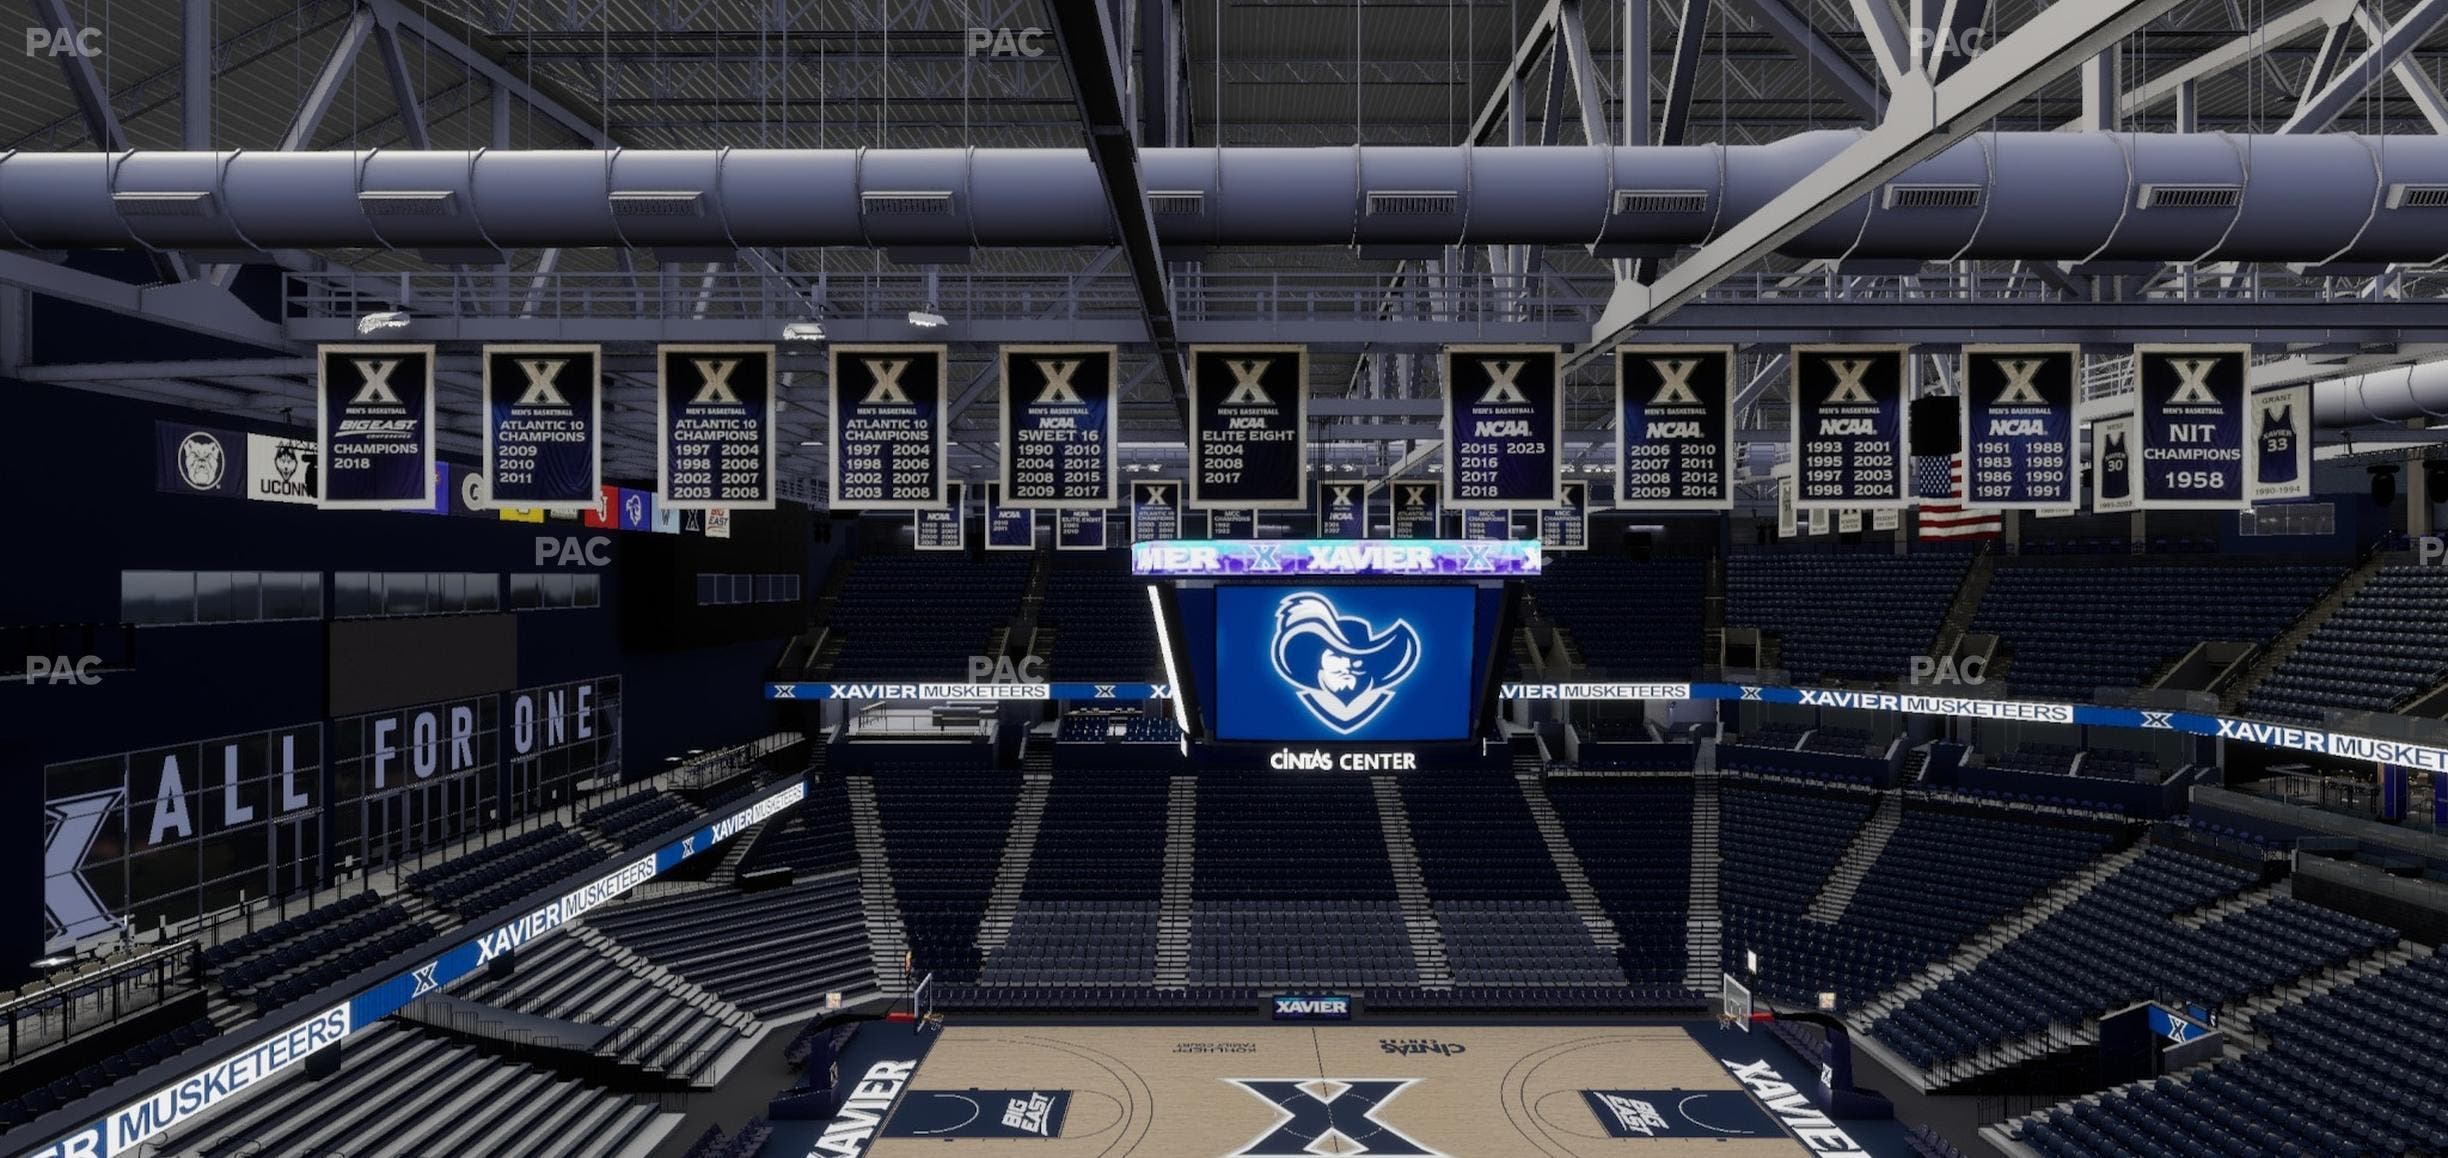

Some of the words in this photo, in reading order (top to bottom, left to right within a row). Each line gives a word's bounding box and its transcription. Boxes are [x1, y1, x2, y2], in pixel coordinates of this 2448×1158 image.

[501, 421, 566, 430] ATLANTIC
[570, 421, 584, 430] 10
[676, 420, 740, 429] ATLANTIC
[744, 420, 757, 429] 10
[846, 420, 910, 429] ATLANTIC
[914, 420, 928, 429] 10
[1039, 418, 1076, 429] NCAA
[1229, 418, 1266, 429] NCAA
[1475, 421, 1529, 437] NCAA
[1820, 419, 1875, 435] NCAA
[1989, 420, 2044, 435] NCAA
[1018, 430, 1076, 441] SWEET
[1082, 430, 1098, 441] 16
[1646, 422, 1701, 438] NCAA
[2169, 424, 2216, 442] NIT
[499, 432, 585, 442] CHAMPIONS
[674, 431, 758, 441] CHAMPIONS
[845, 431, 929, 441] CHAMPIONS
[1202, 431, 1246, 441] ELITE
[1250, 431, 1296, 441] EIGHT
[334, 444, 418, 454] CHAMPIONS
[676, 445, 711, 455] 1997
[721, 445, 759, 455] 2004
[847, 445, 882, 455] 1997
[892, 445, 930, 455] 2004
[1018, 444, 1053, 455] 1990
[1064, 444, 1100, 455] 2010
[1204, 444, 1244, 455] 2004
[1461, 443, 1498, 454] 2015
[1507, 443, 1546, 454] 2023
[1632, 445, 1670, 456] 2006
[1680, 445, 1716, 455] 2010
[1807, 442, 1842, 453] 1993
[1854, 442, 1890, 453] 2001
[1977, 443, 2010, 453] 1961
[2026, 443, 2063, 453] 1988
[2268, 438, 2288, 452] 33
[499, 446, 537, 456] 2009
[2144, 449, 2241, 460] CHAMPIONS
[334, 458, 370, 469] 2018
[500, 459, 535, 470] 2010
[676, 459, 711, 470] 1998
[721, 459, 759, 470] 2006
[847, 459, 882, 470] 1998
[892, 459, 930, 470] 2006
[1017, 458, 1054, 469] 2004
[1064, 458, 1100, 469] 2012
[1204, 458, 1243, 469] 2008
[1462, 457, 1498, 468] 2016
[1632, 459, 1670, 470] 2007
[1681, 459, 1714, 469] 2011
[1807, 456, 1842, 467] 1995
[1854, 456, 1893, 467] 2002
[1977, 457, 2012, 468] 1983
[2026, 457, 2063, 468] 1989
[2108, 460, 2123, 472] 30
[500, 473, 532, 484] 2011
[674, 473, 711, 484] 2002
[721, 473, 759, 484] 2007
[845, 473, 882, 484] 2002
[892, 473, 930, 484] 2007
[1017, 472, 1054, 483] 2008
[1064, 472, 1100, 483] 2015
[1205, 473, 1241, 483] 2017
[1462, 471, 1498, 482] 2017
[1632, 473, 1670, 484] 2008
[1682, 473, 1718, 483] 2012
[1807, 470, 1842, 481] 1997
[1854, 470, 1893, 481] 2003
[1977, 471, 2012, 482] 1986
[2026, 471, 2063, 482] 1990
[2166, 472, 2224, 488] 1958
[674, 487, 711, 498] 2003
[721, 487, 759, 498] 2008
[845, 487, 882, 498] 2003
[892, 487, 930, 498] 2008
[1017, 486, 1055, 497] 2009
[1064, 486, 1100, 497] 2017
[1462, 486, 1498, 497] 2018
[1632, 487, 1670, 498] 2009
[1682, 486, 1717, 496] 2014
[1807, 485, 1842, 496] 1998
[1854, 485, 1893, 496] 2004
[1977, 486, 2012, 497] 1987
[2026, 486, 2060, 497] 1991
[1307, 546, 1435, 570] XAVIER
[830, 685, 916, 699] XAVIER
[924, 686, 1046, 698] MUSKETEERS
[1565, 685, 1687, 698] MUSKETEERS
[1800, 690, 1898, 711] XAVIER
[1907, 696, 2067, 722] MUSKETEERS
[2217, 719, 2325, 752] XAVIER
[148, 734, 308, 845] ALL
[374, 705, 474, 788] FOR
[514, 685, 592, 755] ONE
[1270, 748, 1333, 770] CINTAS
[1340, 753, 1416, 771] CENTER
[711, 808, 753, 843] XAVIER
[755, 783, 803, 820] MUSKETEERS
[476, 903, 560, 966] XAVIER
[565, 855, 654, 917] MUSKETEERS
[1276, 1000, 1347, 1014] XAVIER
[119, 1009, 344, 1148] MUSKETEERS
[1001, 1098, 1028, 1128] BIG
[1020, 1092, 1049, 1133] EAST
